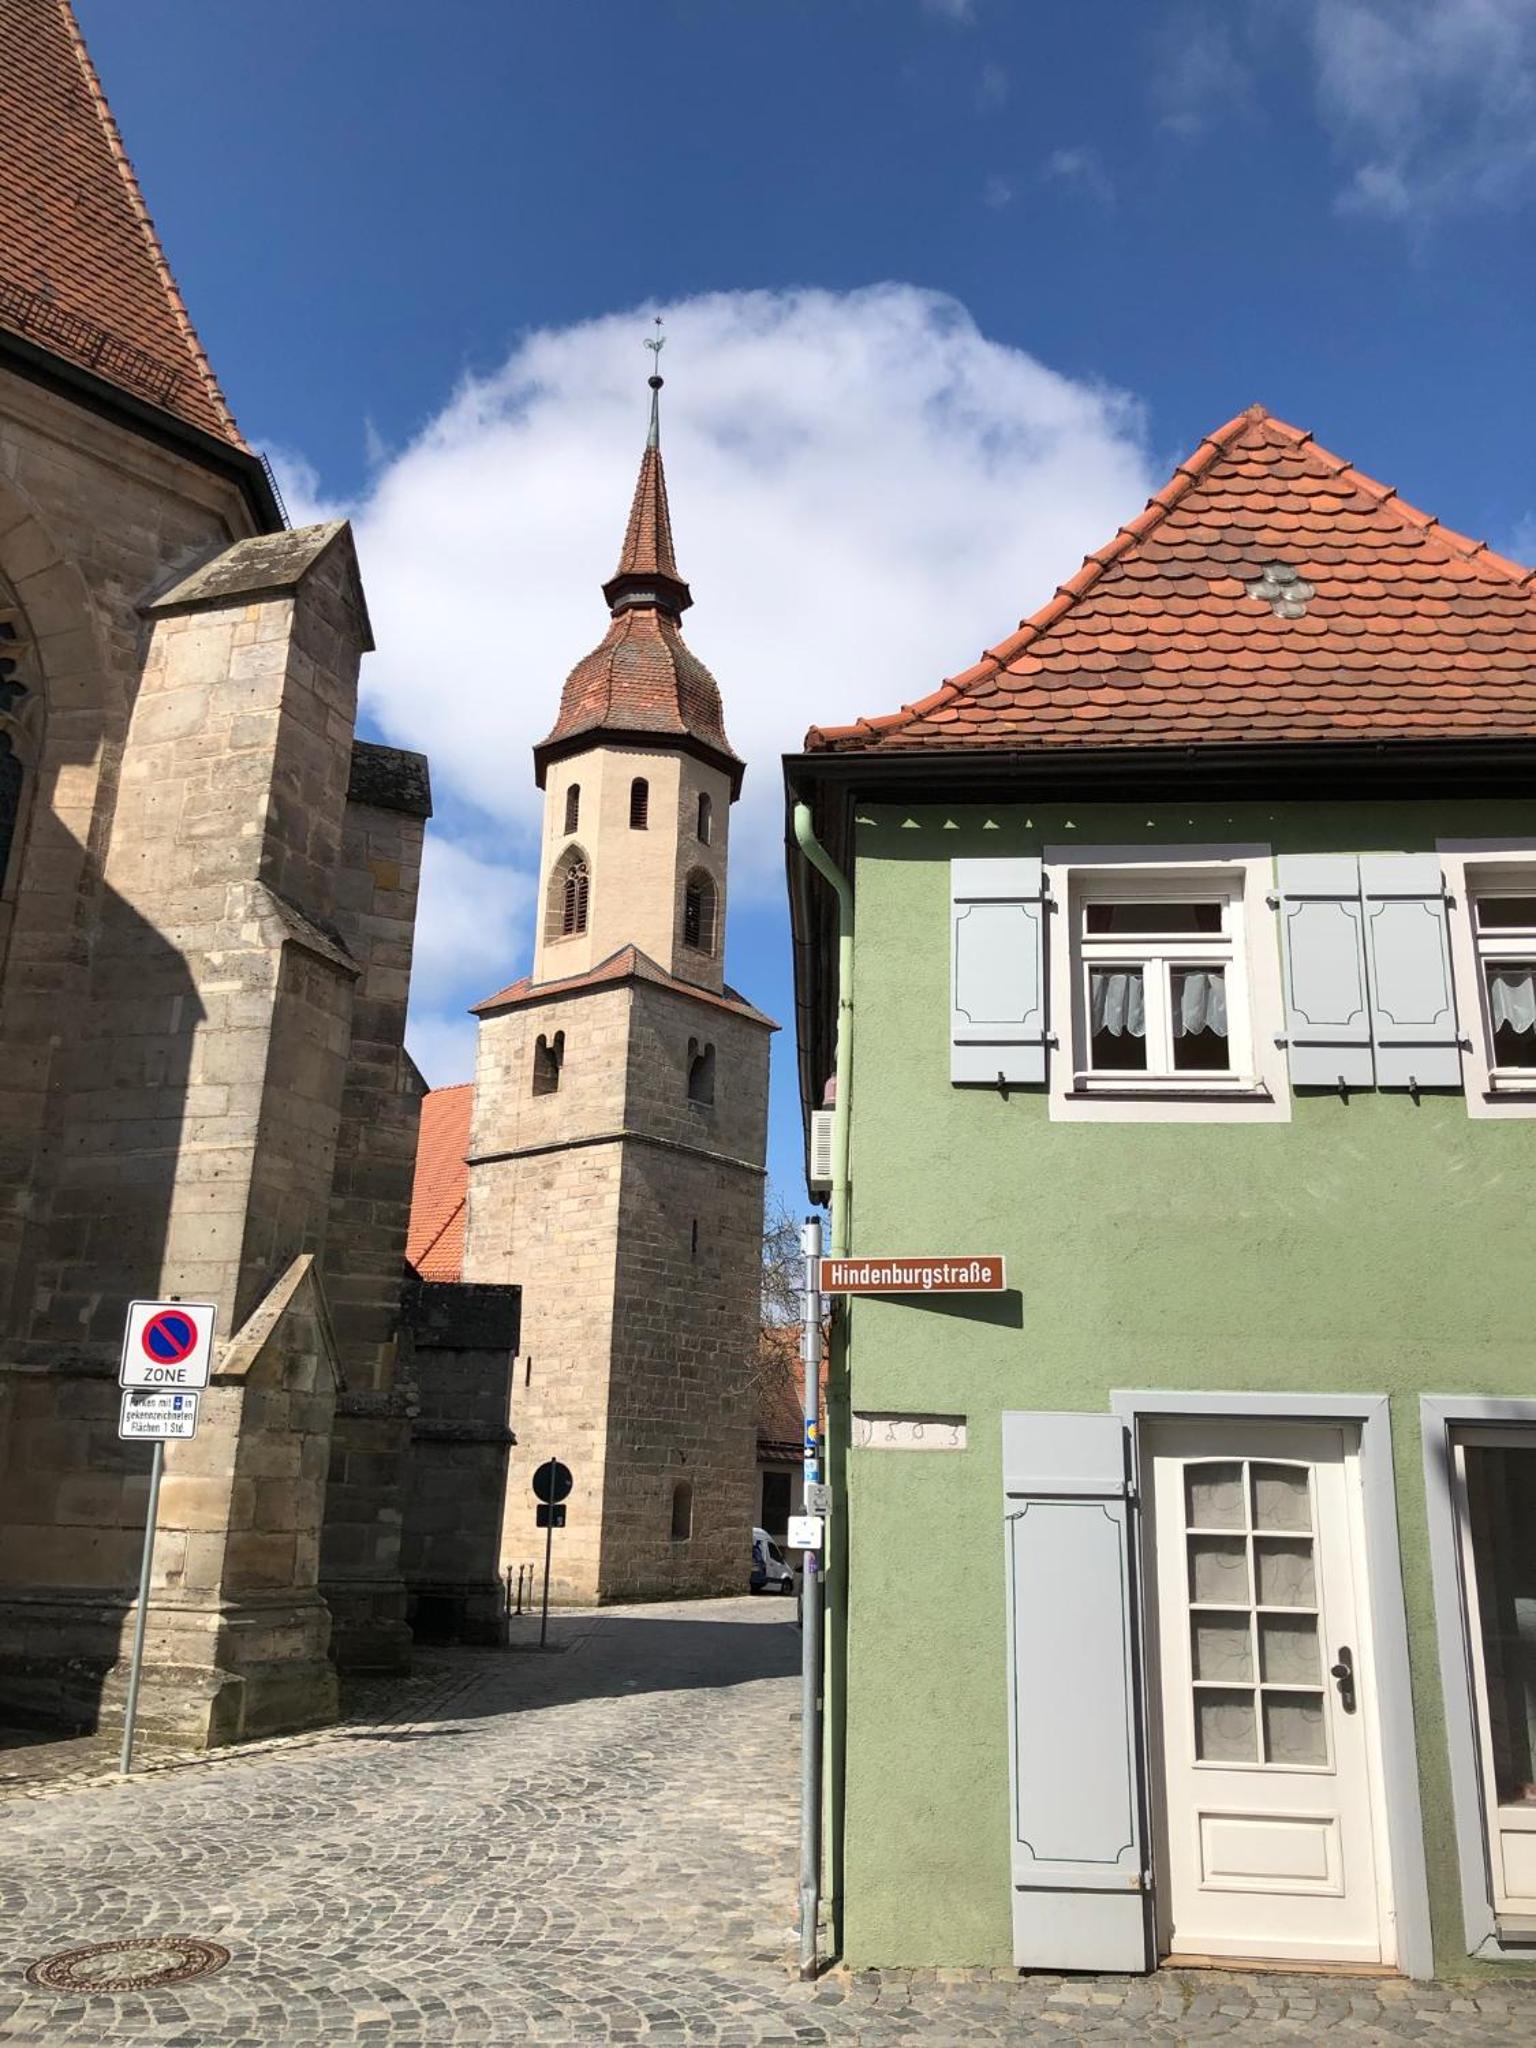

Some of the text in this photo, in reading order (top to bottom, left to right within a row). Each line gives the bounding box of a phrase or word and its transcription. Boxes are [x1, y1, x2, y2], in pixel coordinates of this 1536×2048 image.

[831, 1262, 992, 1289] Hindenburgstraße
[143, 1367, 187, 1383] ZONE
[131, 1422, 161, 1433] Flächen
[170, 1422, 185, 1433] Std.
